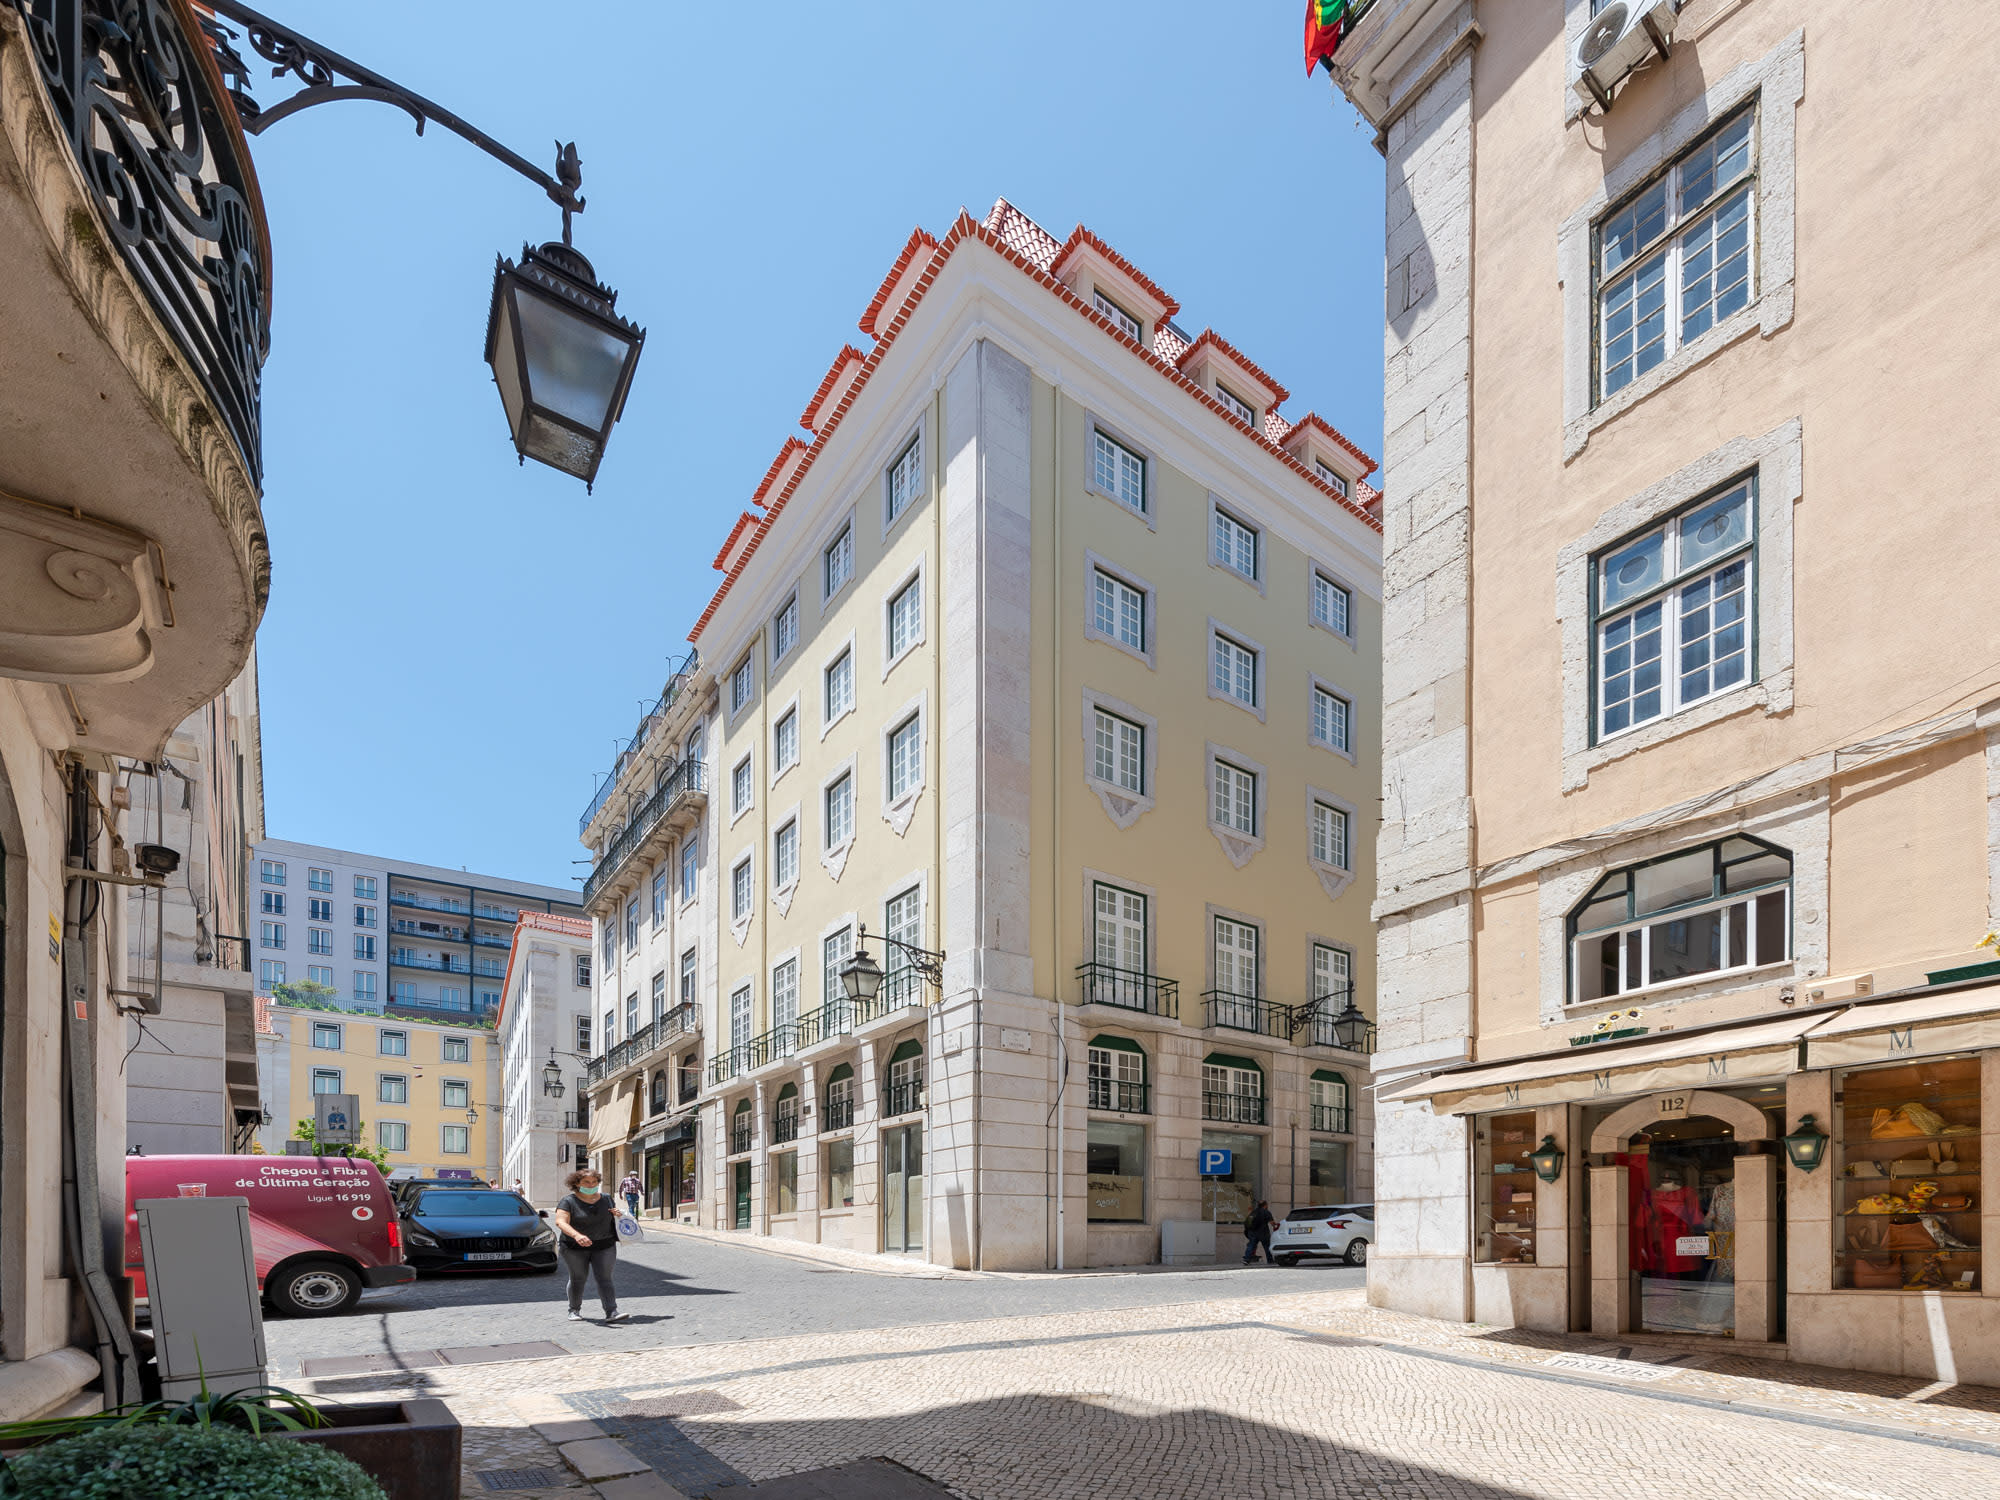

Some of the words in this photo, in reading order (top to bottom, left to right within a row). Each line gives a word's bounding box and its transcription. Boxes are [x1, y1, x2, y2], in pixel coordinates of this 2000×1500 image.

[1888, 1025, 1913, 1050] M
[1708, 1055, 1728, 1075] M
[1594, 1070, 1610, 1091] M
[1505, 1084, 1519, 1103] M
[1661, 1097, 1684, 1111] 112
[1206, 1151, 1224, 1172] P
[260, 1166, 318, 1177] Chegou
[321, 1168, 330, 1176] a
[333, 1166, 368, 1176] Fibra
[235, 1178, 255, 1188] de
[259, 1176, 310, 1188] Última
[313, 1177, 370, 1189] Geração
[307, 1194, 333, 1203] Ligue
[336, 1193, 349, 1201] 16
[351, 1193, 371, 1201] 919
